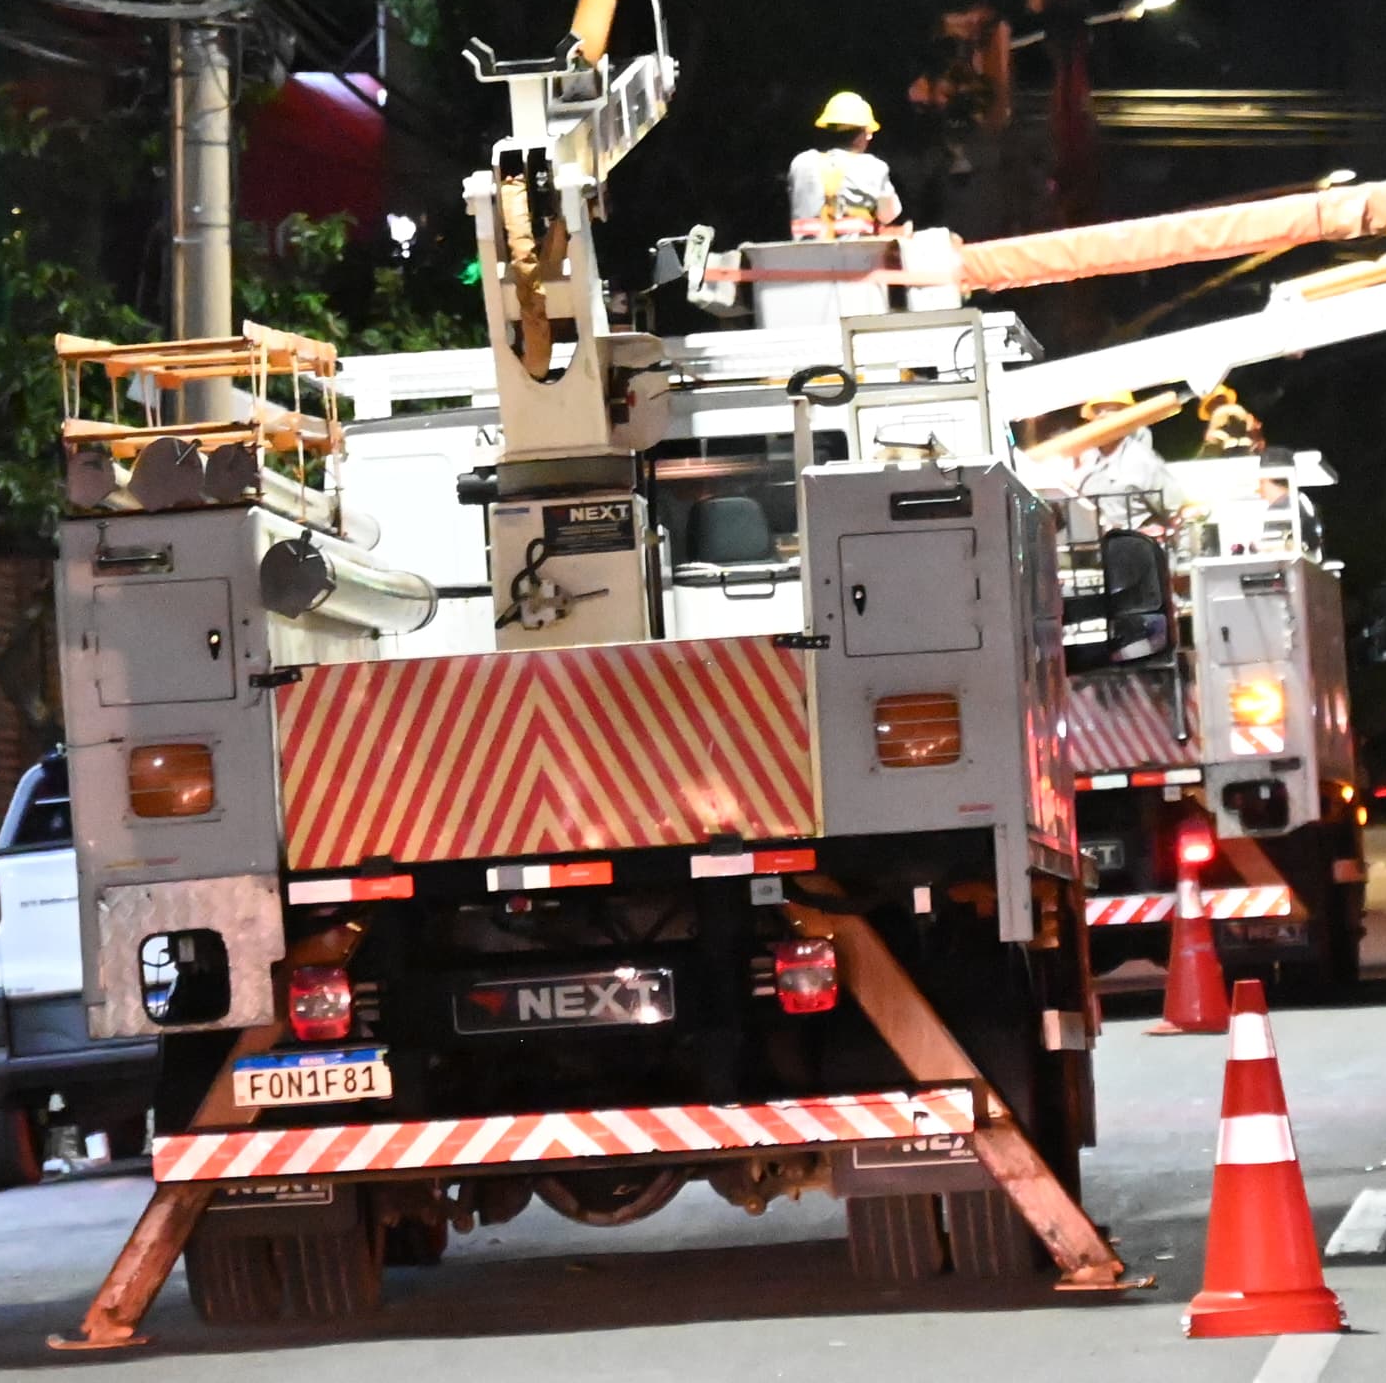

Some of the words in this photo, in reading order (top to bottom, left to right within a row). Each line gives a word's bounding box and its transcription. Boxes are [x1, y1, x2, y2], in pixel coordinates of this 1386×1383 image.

[570, 503, 630, 523] NEXT
[517, 980, 660, 1022] NEXT
[249, 1065, 376, 1100] FON1F81
